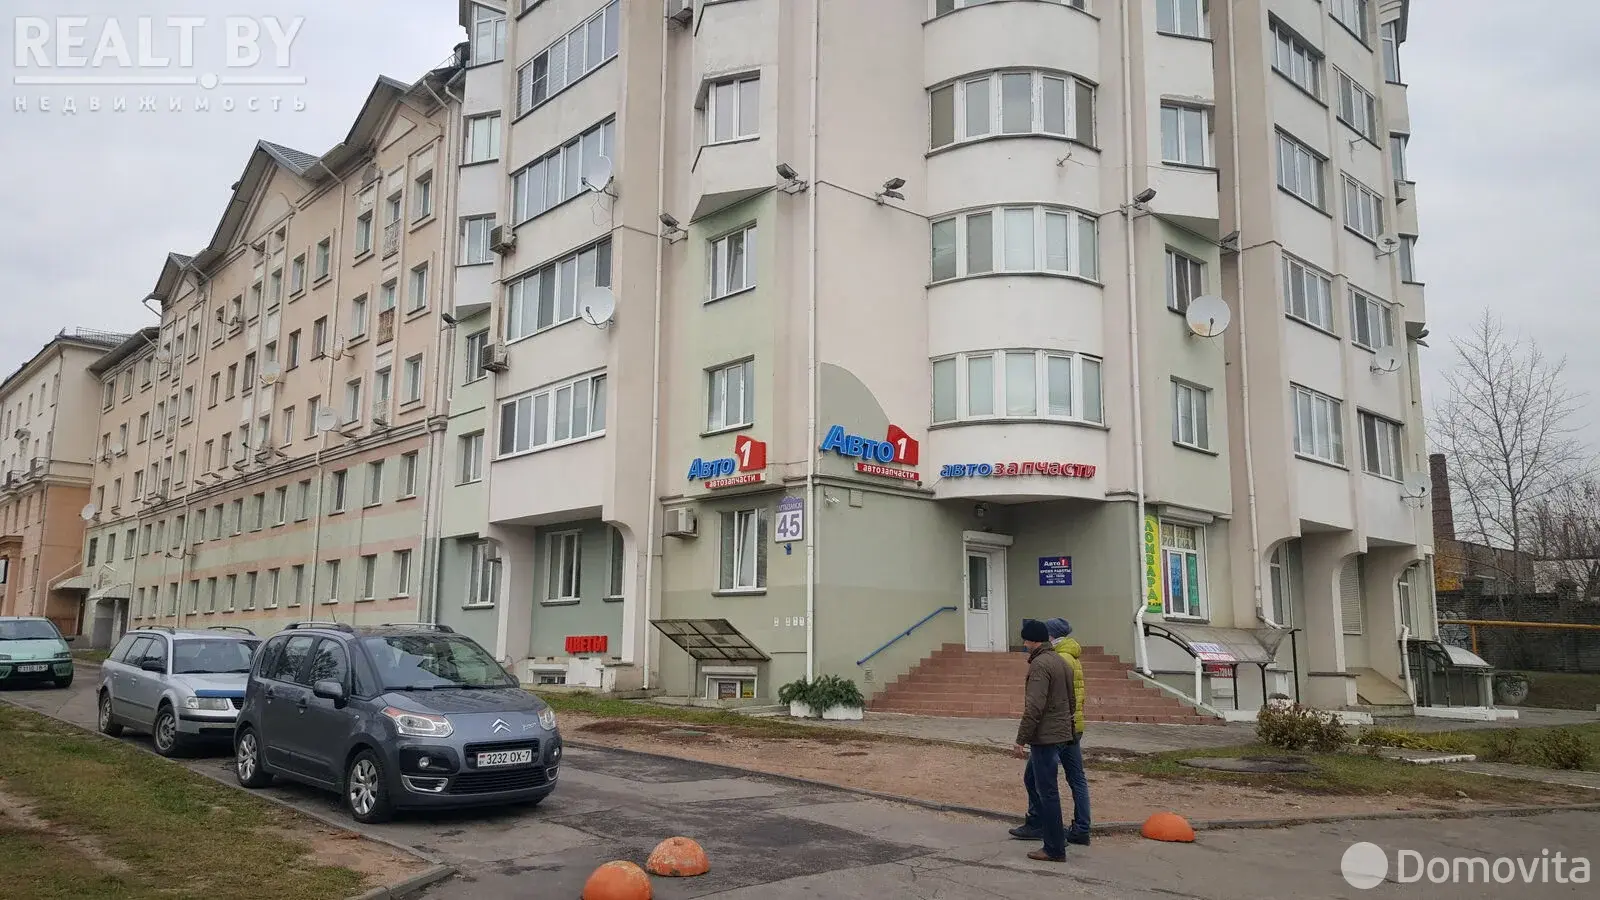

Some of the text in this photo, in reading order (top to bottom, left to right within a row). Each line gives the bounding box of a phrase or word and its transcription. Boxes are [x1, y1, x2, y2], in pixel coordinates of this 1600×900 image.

[740, 440, 752, 467] 1
[896, 437, 908, 460] 1
[862, 464, 916, 479] автозапчасти
[940, 462, 1097, 480] автозапчасти
[708, 474, 757, 489] автозапчасти
[777, 513, 801, 538] 45
[565, 635, 608, 655] ЦВЕТЫ
[486, 753, 508, 765] 3232
[510, 750, 531, 762] OX-7
